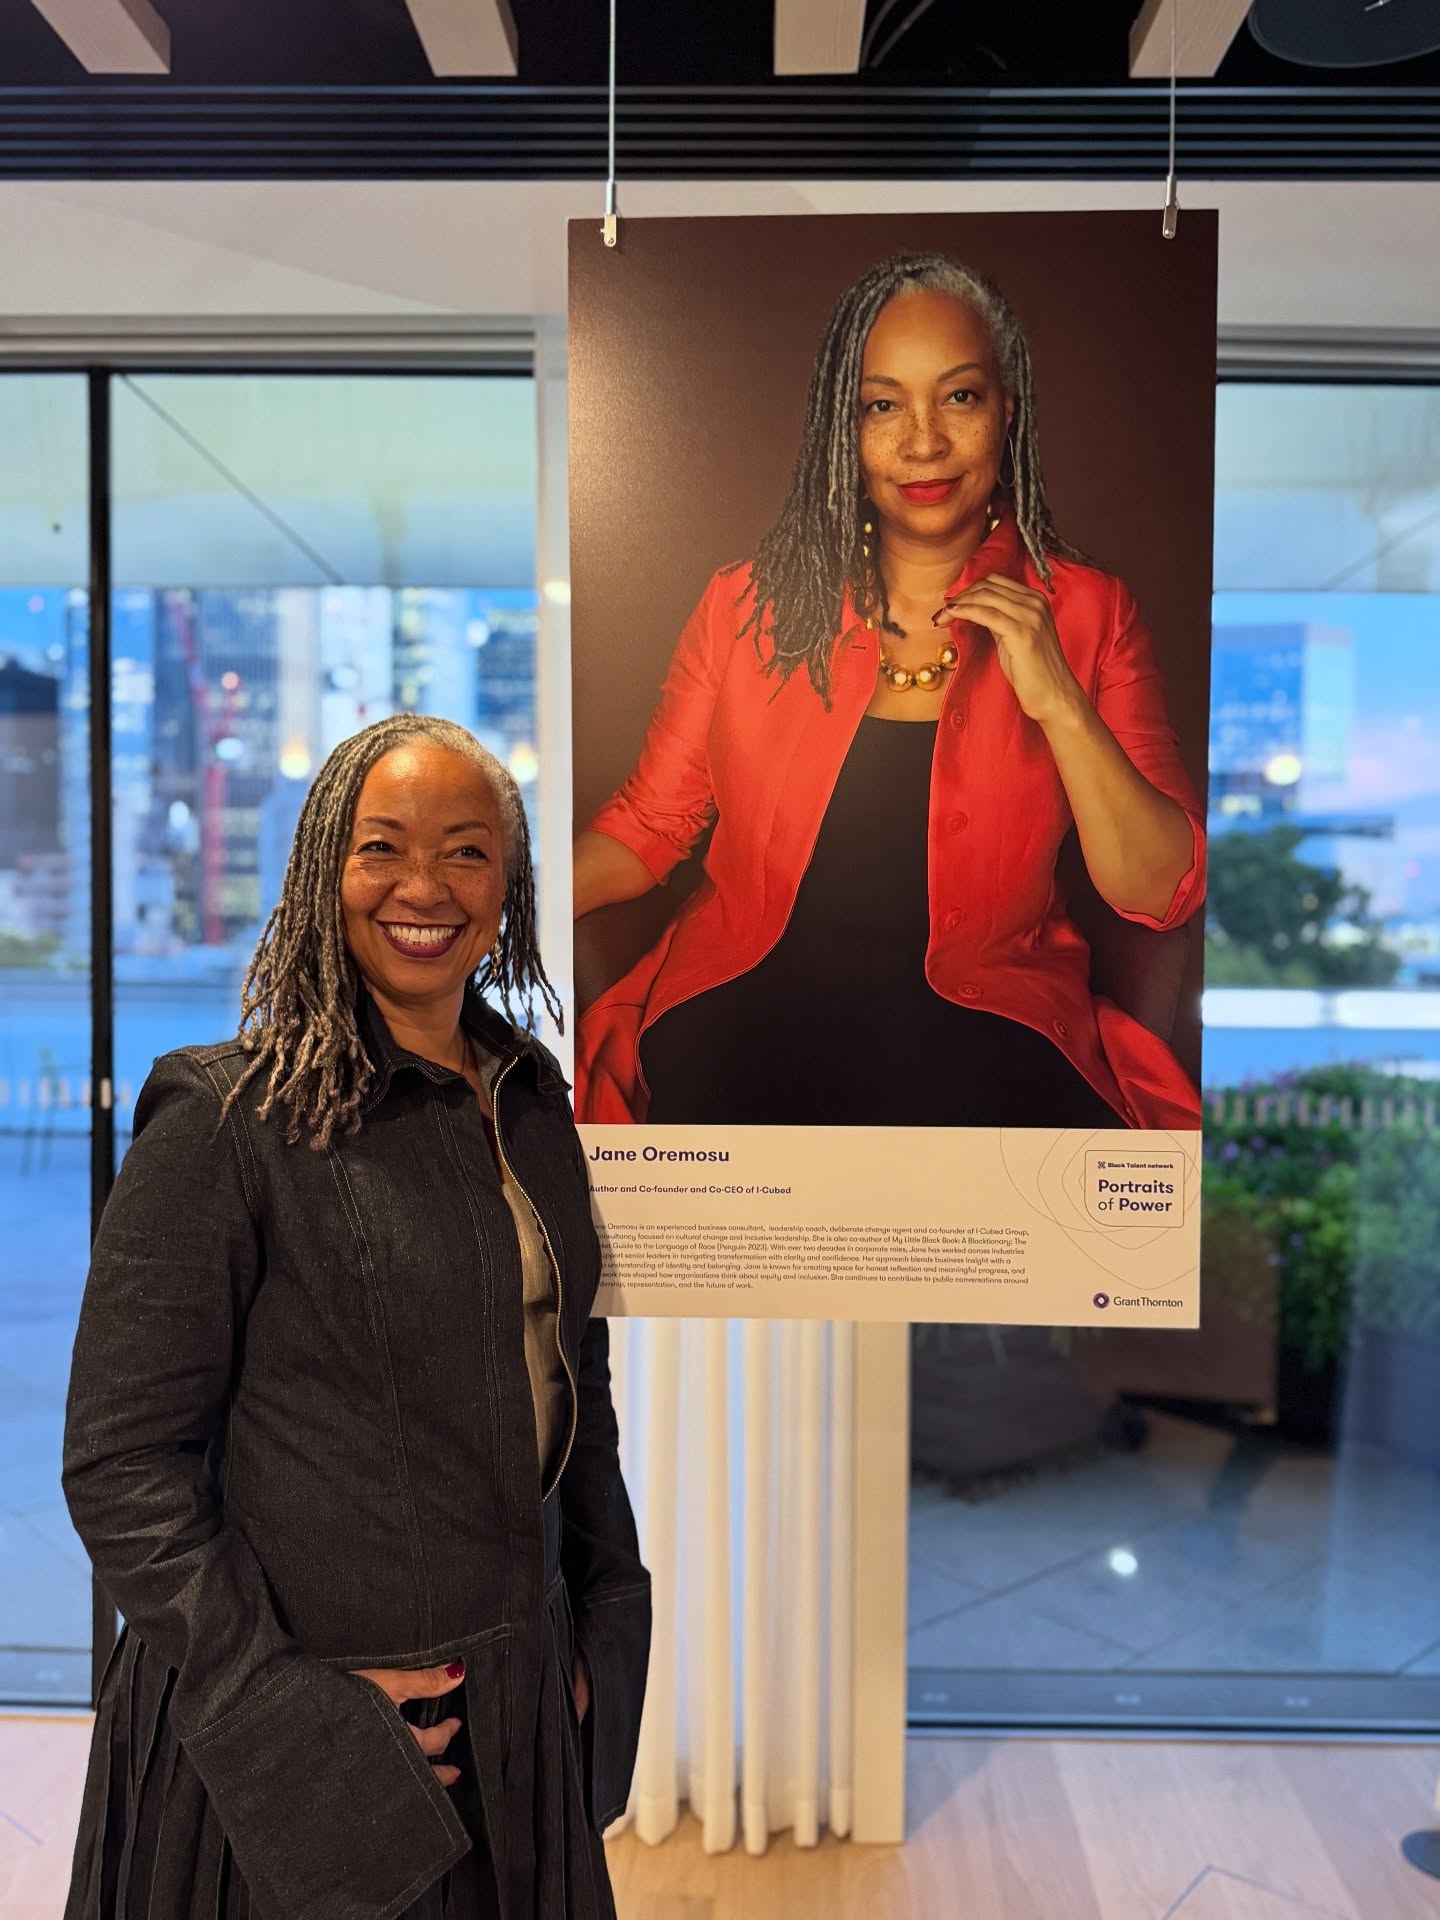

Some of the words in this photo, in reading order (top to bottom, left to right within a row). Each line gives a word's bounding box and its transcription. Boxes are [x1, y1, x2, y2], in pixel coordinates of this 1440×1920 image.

[589, 1146, 636, 1162] Jane
[642, 1146, 730, 1162] Oremosu
[589, 1185, 618, 1193] Author
[620, 1185, 637, 1193] and
[639, 1185, 688, 1194] Co-founder
[690, 1186, 707, 1194] and
[709, 1186, 744, 1194] Co-CEO
[745, 1186, 755, 1194] of
[756, 1186, 792, 1194] I-Cubed
[1098, 1180, 1174, 1194] Portraits
[1098, 1198, 1114, 1211] of
[1119, 1198, 1172, 1212] Power
[1113, 1296, 1140, 1307] Grant
[1140, 1297, 1183, 1308] Thornton
